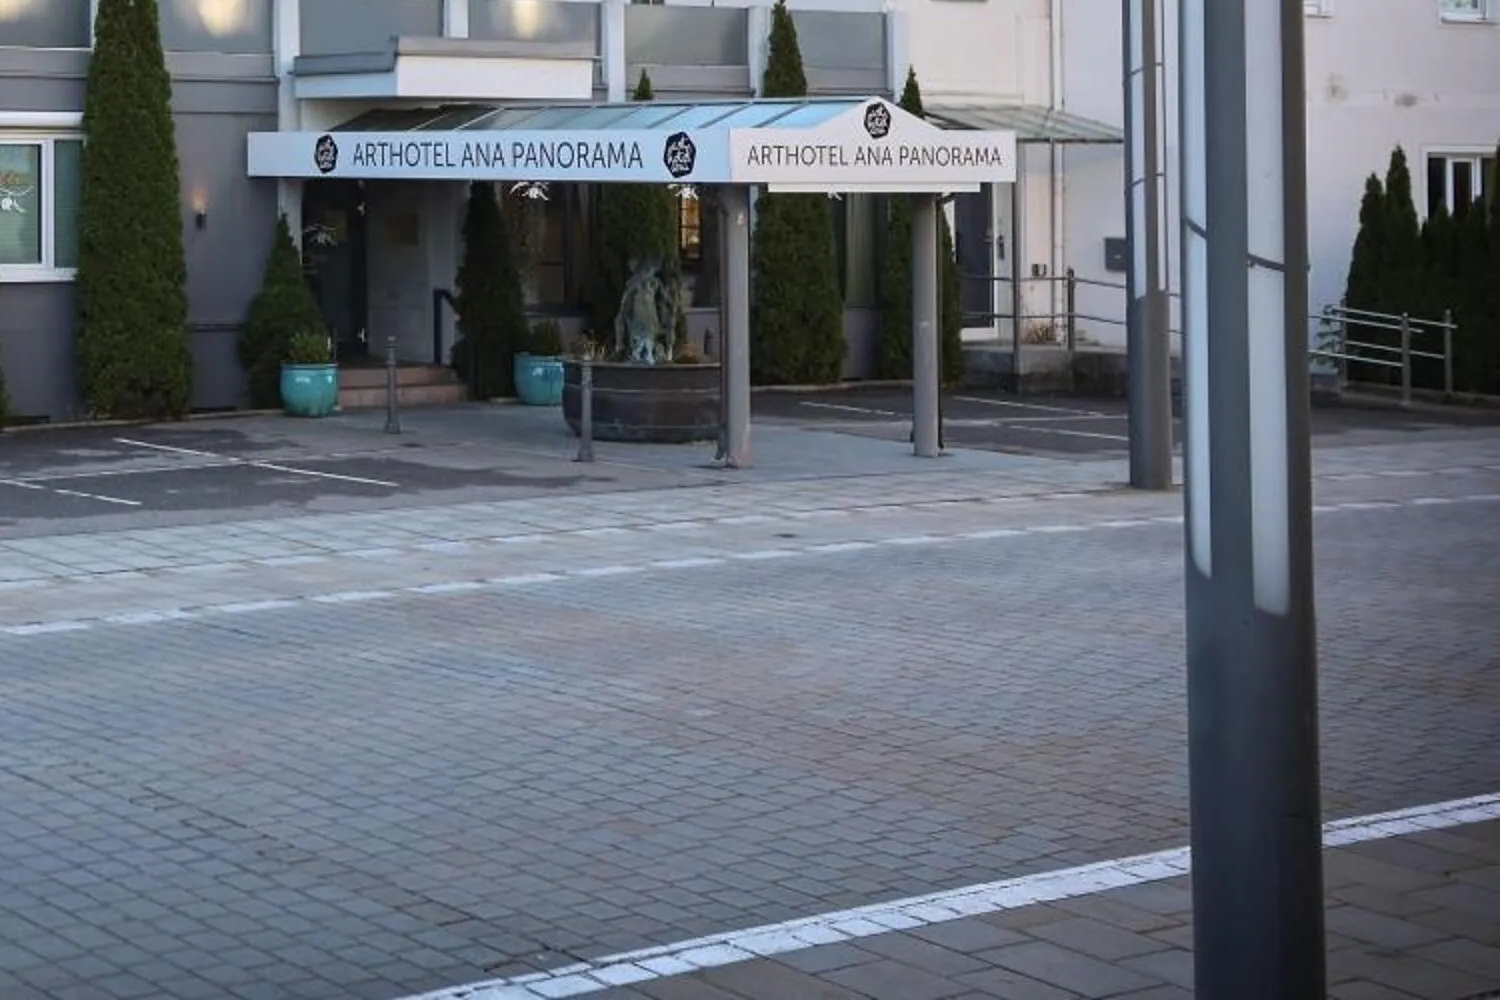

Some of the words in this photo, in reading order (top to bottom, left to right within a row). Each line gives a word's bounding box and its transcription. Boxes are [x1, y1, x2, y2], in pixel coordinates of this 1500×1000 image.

[352, 142, 455, 168] ARTHOTEL
[461, 142, 506, 168] ANA
[512, 141, 644, 169] PANORAMA
[747, 145, 848, 166] ARTHOTEL
[854, 145, 893, 166] ANA
[900, 146, 1002, 166] PANORAMA
